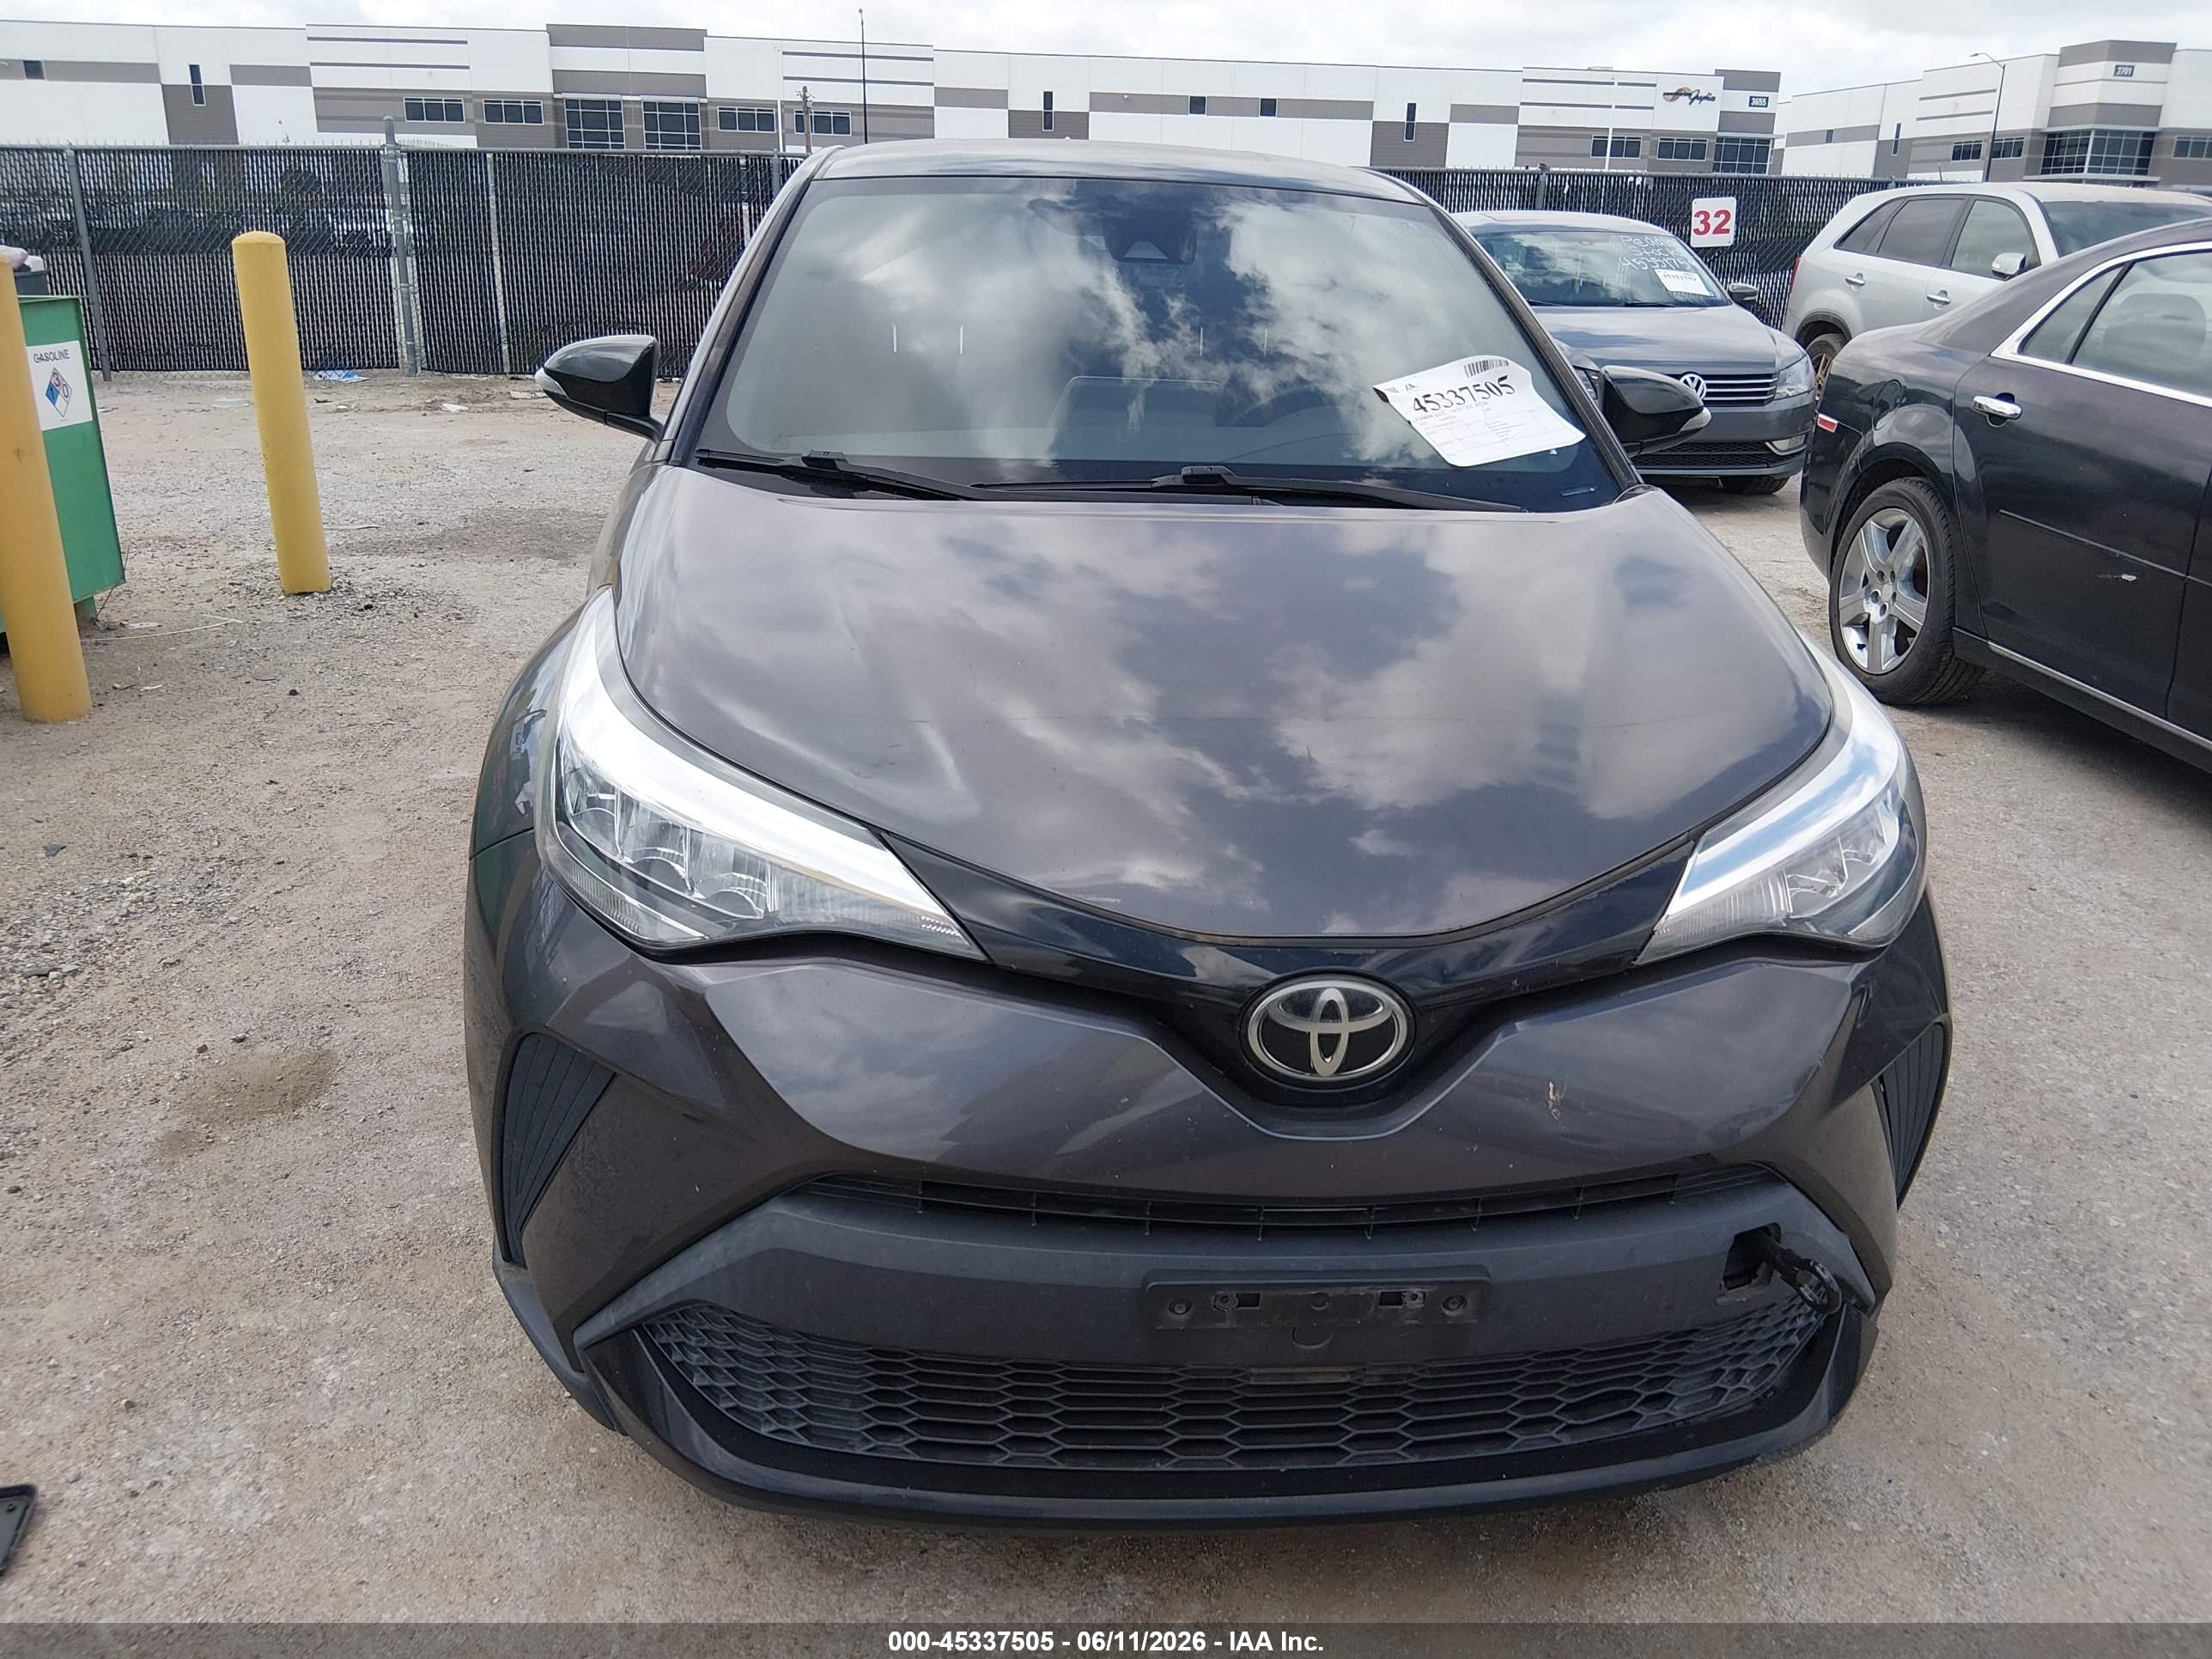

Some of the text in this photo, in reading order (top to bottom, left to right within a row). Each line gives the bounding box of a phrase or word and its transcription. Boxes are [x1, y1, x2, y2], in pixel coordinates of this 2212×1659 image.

[2116, 67, 2133, 76] 3701
[1750, 97, 1767, 106] 3655
[1692, 209, 1731, 236] 32
[33, 349, 70, 363] GASOLINE
[52, 372, 61, 387] 3
[62, 384, 70, 398] 0
[1412, 374, 1516, 413] 45337505
